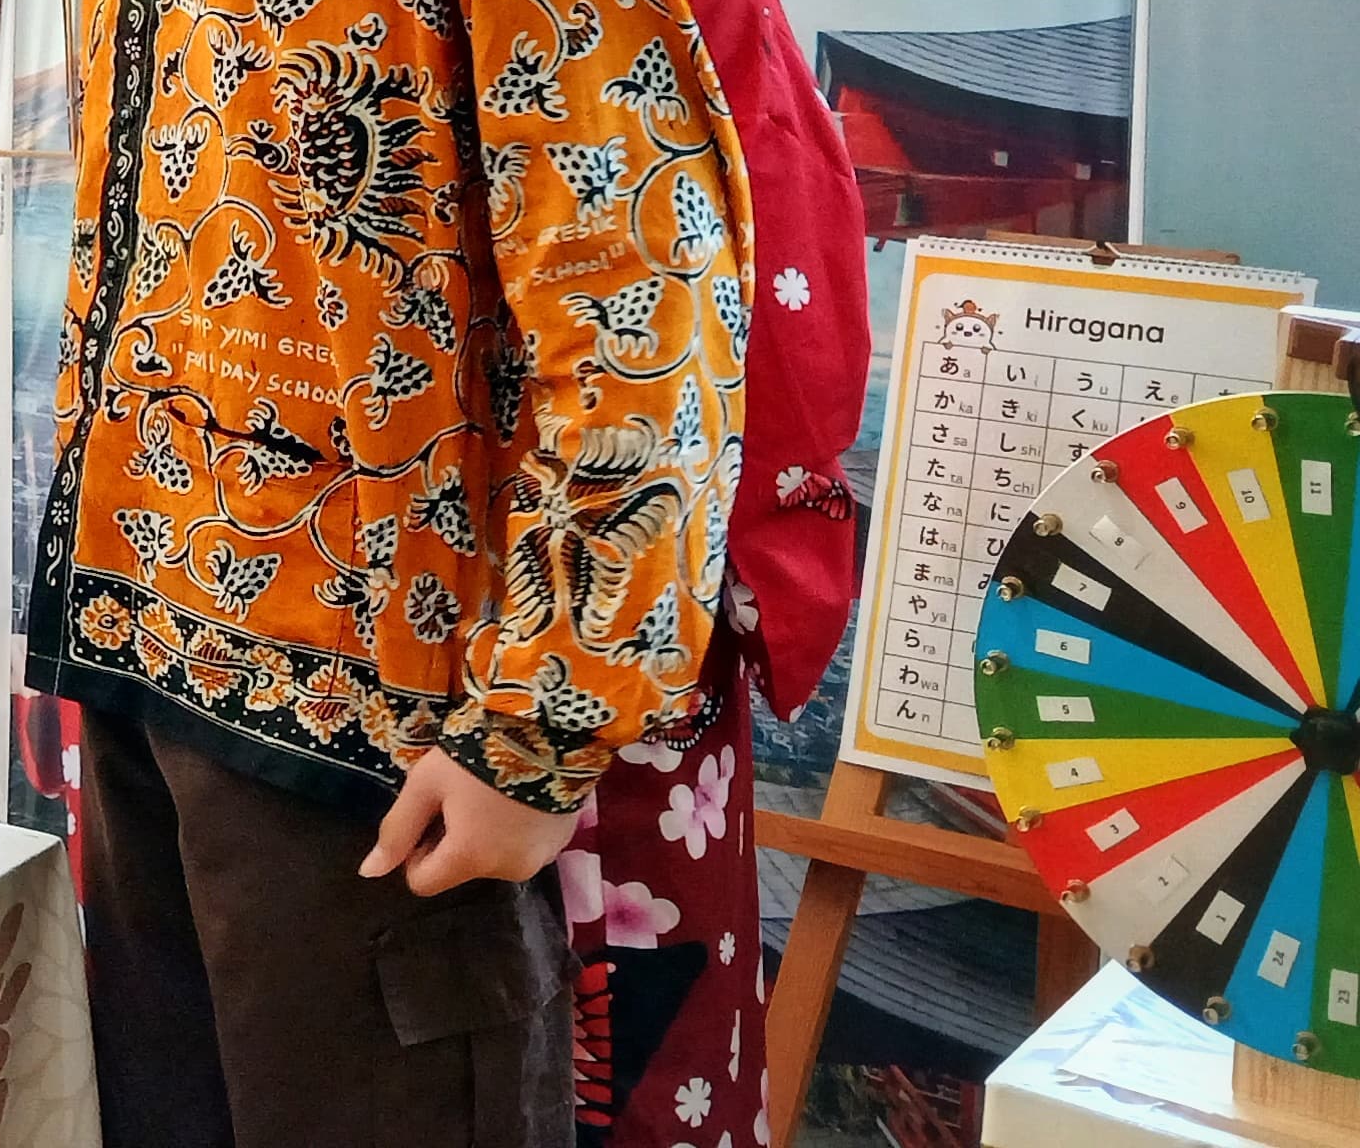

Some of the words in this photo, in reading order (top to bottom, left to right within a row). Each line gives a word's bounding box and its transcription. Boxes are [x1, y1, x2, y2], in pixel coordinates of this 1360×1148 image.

[219, 324, 267, 350] YIMI
[1025, 308, 1166, 344] Hiragana
[221, 360, 261, 393] DAY
[939, 355, 960, 376] あ
[962, 368, 971, 379] a
[1006, 364, 1026, 382] い
[1077, 372, 1094, 392] う
[1145, 380, 1165, 401] え
[933, 390, 955, 410] か
[958, 401, 974, 415] ka
[1000, 399, 1020, 419] き
[1071, 408, 1087, 429] く
[932, 424, 950, 444] さ
[953, 437, 968, 448] sa
[999, 432, 1017, 453] し
[1020, 443, 1042, 459] shi
[926, 457, 946, 478] た
[993, 467, 1012, 488] ち
[1012, 482, 1035, 496] chi
[922, 491, 942, 511] な
[946, 506, 963, 518] na
[990, 502, 1011, 522] に
[1240, 489, 1255, 505] 10
[918, 526, 939, 546] は
[940, 539, 958, 553] ha
[1114, 534, 1125, 548] 8
[913, 563, 931, 582] ま
[933, 575, 955, 587] ma
[908, 594, 928, 615] や
[931, 611, 948, 624] ya
[904, 628, 922, 649] ら
[898, 664, 920, 686] わ
[920, 679, 940, 691] wa
[896, 700, 917, 720] ん
[921, 713, 930, 724] n
[1061, 703, 1070, 715] 5
[1070, 767, 1079, 777] 4
[1110, 823, 1120, 835] 3
[1158, 876, 1169, 887] 2
[1272, 950, 1285, 967] 24
[1338, 990, 1350, 1005] 23
